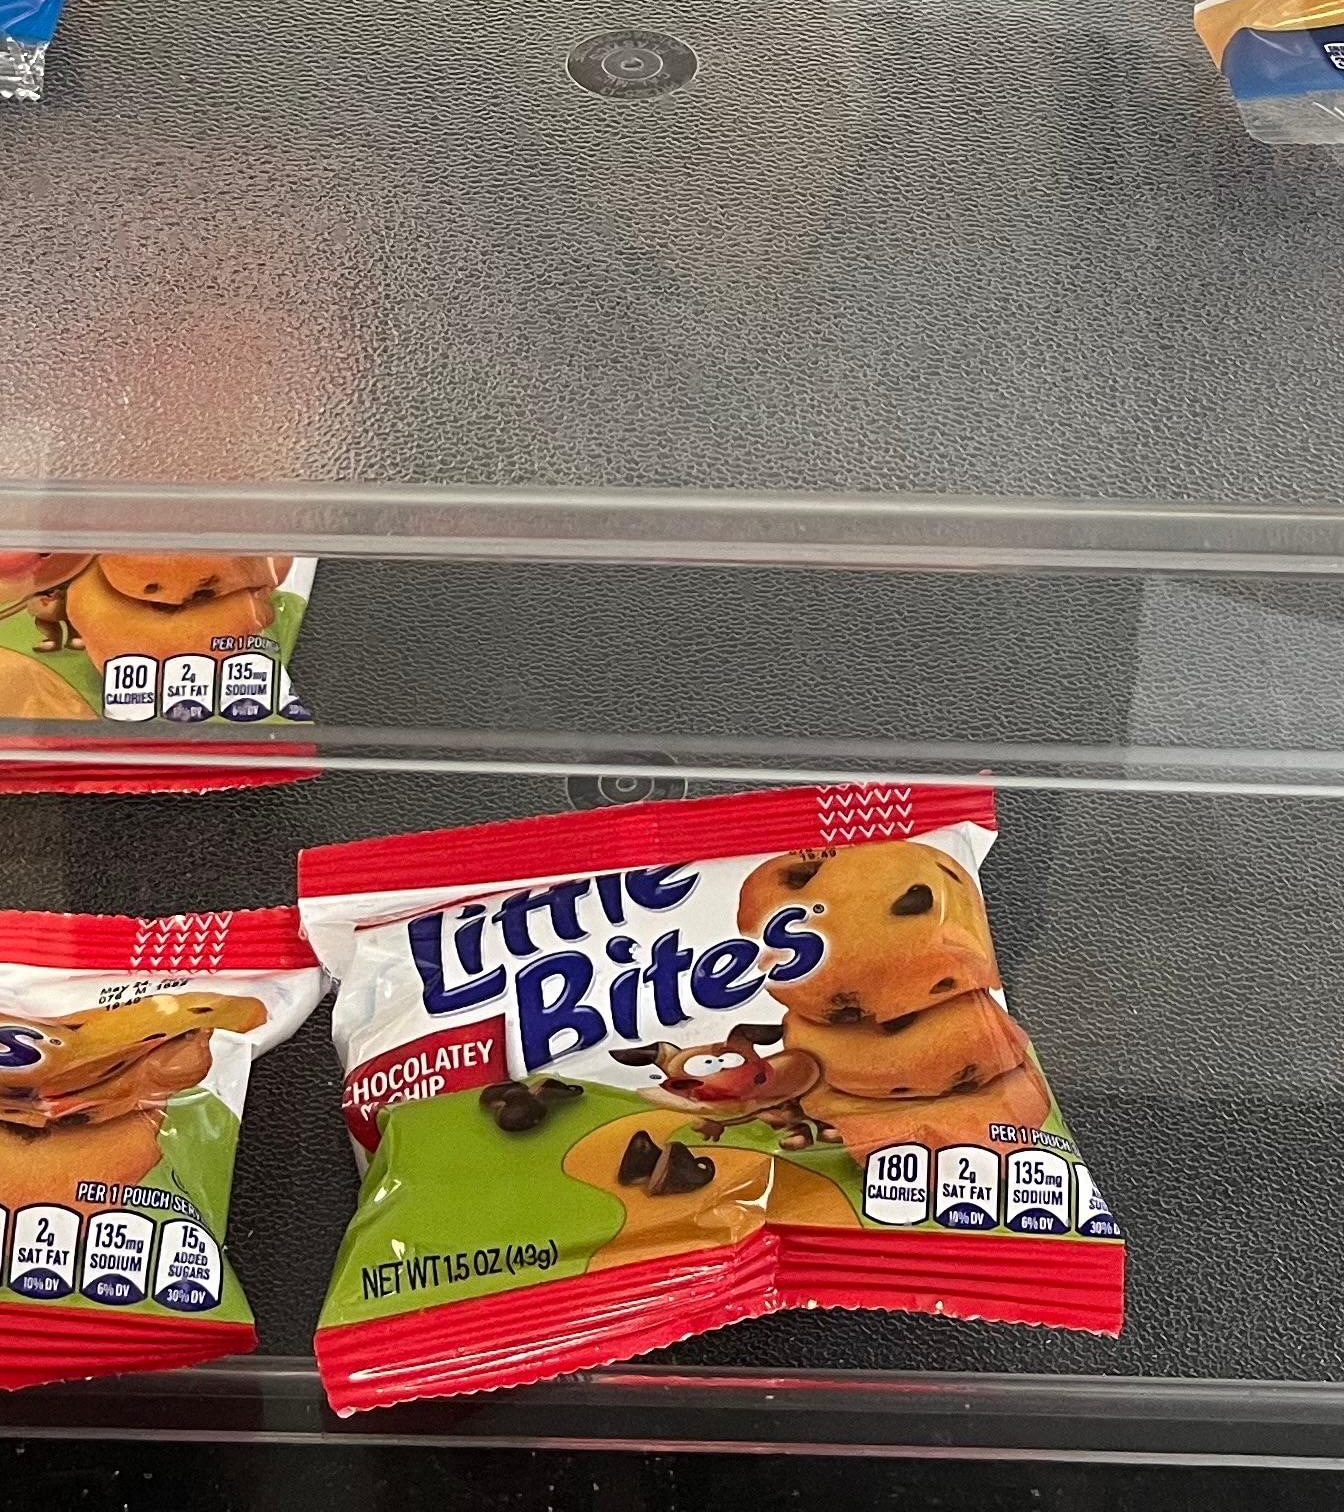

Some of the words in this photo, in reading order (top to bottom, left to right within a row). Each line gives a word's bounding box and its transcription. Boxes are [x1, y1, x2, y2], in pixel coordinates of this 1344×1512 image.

[212, 636, 234, 651] PER
[114, 664, 148, 689] 180
[182, 663, 196, 684] 2g
[227, 662, 267, 682] 135mg
[106, 692, 154, 705] CALORIES
[167, 685, 186, 698] SAT
[190, 684, 209, 697] FAT
[225, 683, 268, 697] SODIUM
[514, 907, 826, 1075] Bites
[991, 1124, 1017, 1143] PER
[1021, 1127, 1028, 1144] 1
[1032, 1129, 1071, 1152] POUCH
[877, 1153, 919, 1183] 180
[958, 1156, 977, 1184] 2g
[1014, 1160, 1063, 1188] 135mg
[77, 1182, 106, 1202] PER
[109, 1185, 118, 1203] 1
[123, 1185, 170, 1209] POUCH
[867, 1184, 926, 1204] CALORIES
[942, 1182, 965, 1199] SAT
[969, 1185, 993, 1202] FAT
[1013, 1188, 1063, 1206] SODIUM
[948, 1210, 970, 1225] 10%
[970, 1211, 984, 1226] DV
[1021, 1216, 1039, 1231] 6%
[1039, 1216, 1053, 1231] DV
[35, 1217, 55, 1247] 2g
[95, 1222, 145, 1253] 135mg
[181, 1225, 207, 1254] 15g
[17, 1247, 42, 1265] SAT
[45, 1248, 71, 1267] FAT
[89, 1253, 143, 1273] SODIUM
[173, 1254, 209, 1268] ADDED
[168, 1264, 211, 1281] SUGARS
[362, 1261, 404, 1300] NET
[406, 1255, 441, 1291] WT
[473, 1248, 502, 1277] OZ
[506, 1239, 559, 1275] (43g)
[23, 1276, 43, 1291] 10%
[44, 1278, 60, 1292] DV
[97, 1281, 115, 1297] 6%
[115, 1284, 131, 1298] DV
[166, 1287, 190, 1304] 30%
[190, 1289, 207, 1305] DV
